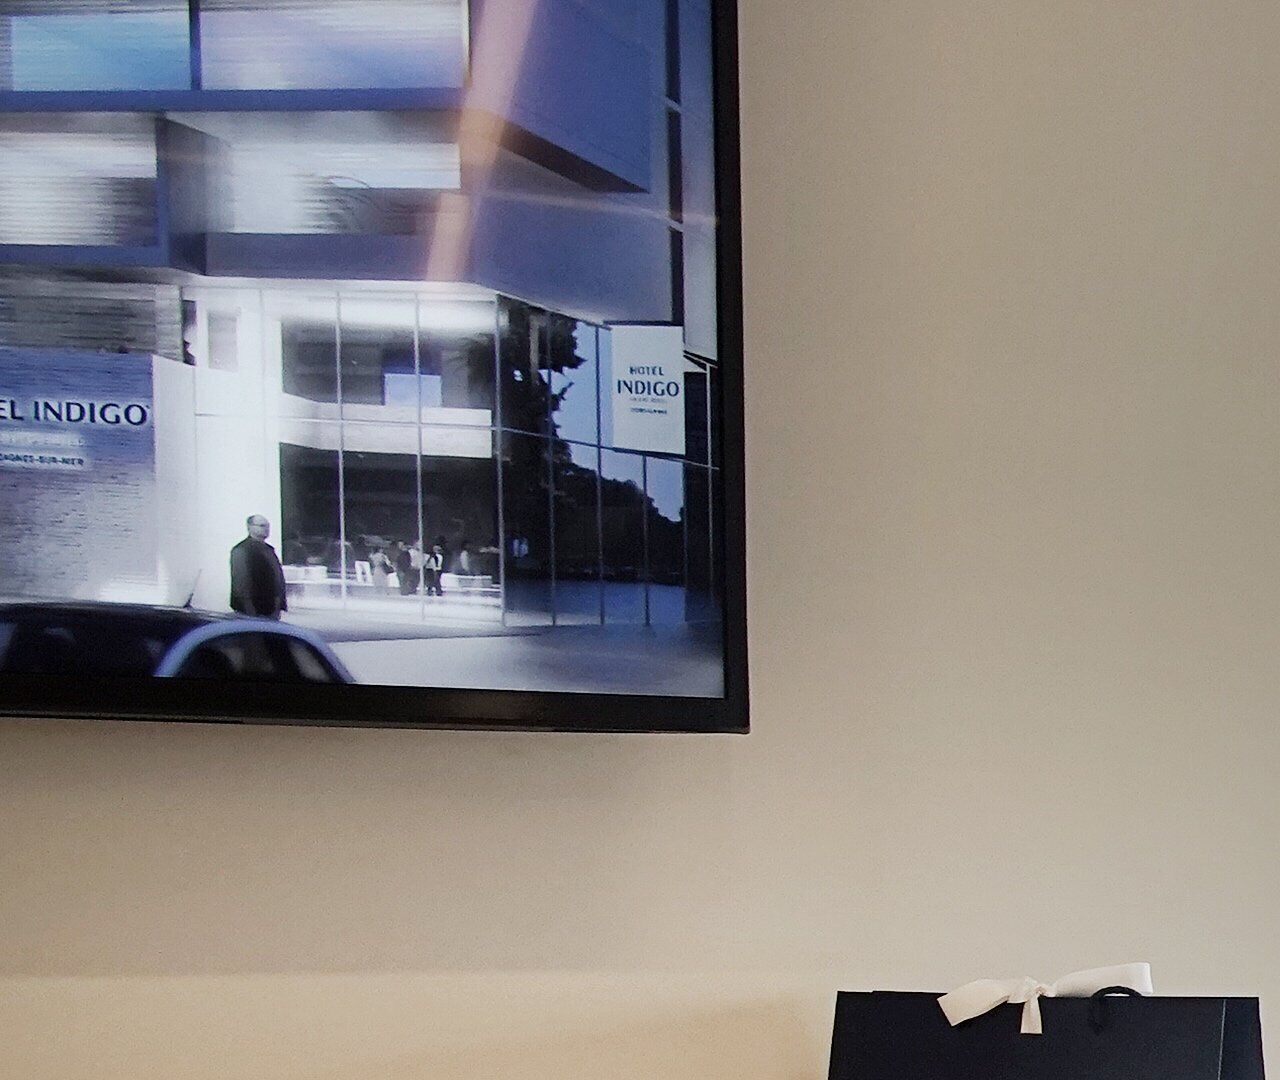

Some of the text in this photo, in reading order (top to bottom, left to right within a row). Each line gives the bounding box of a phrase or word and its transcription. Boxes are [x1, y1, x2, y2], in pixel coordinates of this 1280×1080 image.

[628, 366, 665, 376] HOTEL
[617, 380, 680, 397] INDIGO
[33, 400, 148, 426] INDIGO
